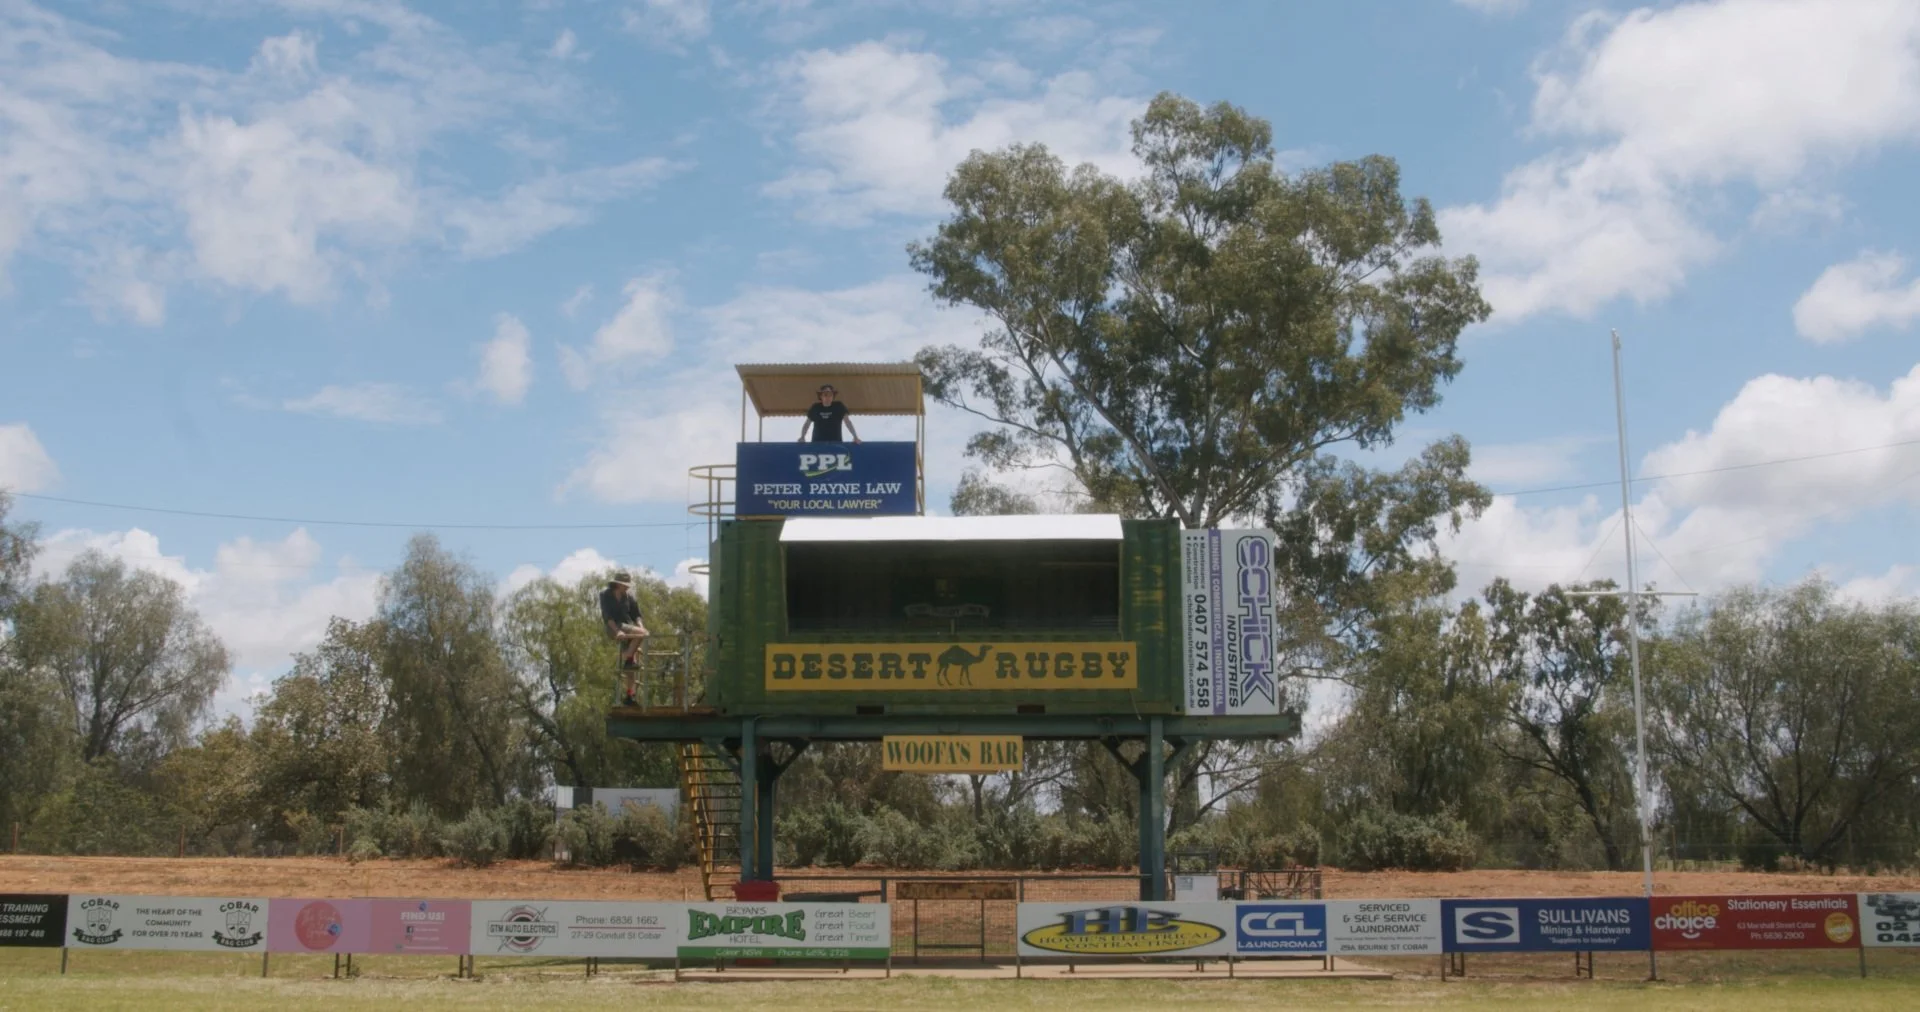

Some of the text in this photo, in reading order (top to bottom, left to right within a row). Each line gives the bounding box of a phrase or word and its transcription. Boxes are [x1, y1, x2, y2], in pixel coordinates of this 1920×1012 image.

[799, 454, 852, 471] PPL
[753, 482, 902, 495] PETER PAYNE LAW
[768, 499, 883, 509] "YOUR LOCAL LAWYER"
[1211, 536, 1223, 707] MINING COMMERICAL INDUSTRIAL
[1237, 536, 1274, 706] SCHICK
[1194, 594, 1210, 708] 0407 574 558
[772, 652, 1130, 680] DESERT RUGBY
[1226, 614, 1239, 708] INDUSTRIES
[886, 741, 1019, 765] WOOFA'S BAR
[3, 903, 49, 913] TRAINING
[81, 898, 120, 911] COBAR
[219, 901, 259, 913] COBAR
[1359, 903, 1410, 912] SERVICED
[1670, 901, 1720, 917] office
[1728, 898, 1848, 912] Stationery Essentials
[726, 906, 767, 915] BRYAN'S
[815, 908, 876, 918] Great Beer!
[401, 911, 445, 921] FIND US!
[575, 915, 659, 925] Phone: 6836 1662
[1343, 914, 1427, 923] & SELF SERVICE
[1538, 909, 1630, 924] SULLIVANS
[688, 909, 806, 941] EMPIRE
[815, 919, 844, 930] Great
[1654, 913, 1716, 930] choice
[1747, 921, 1775, 929] Marshall
[1776, 921, 1796, 929] Street
[1797, 921, 1816, 929] Cobar
[1876, 922, 1908, 931] 02
[15, 929, 29, 937] 197
[490, 924, 556, 934] GTM AUTO ELECTRICS
[1350, 925, 1421, 933] LAUNDROMAT
[1540, 926, 1631, 937] Mining & Hardware
[571, 931, 662, 940] 27-29 Conduit St Cobar
[729, 934, 762, 944] HOTEL
[815, 931, 844, 941] Great
[1039, 932, 1212, 944] HOWIE'S ELECTRICAL
[1763, 932, 1783, 940] 6836
[1784, 932, 1805, 940] 2900
[1064, 940, 1186, 949] CONTRACTING
[1237, 940, 1325, 949] LAUNDROMAT
[742, 948, 763, 956] NSW
[777, 948, 802, 956] Phone
